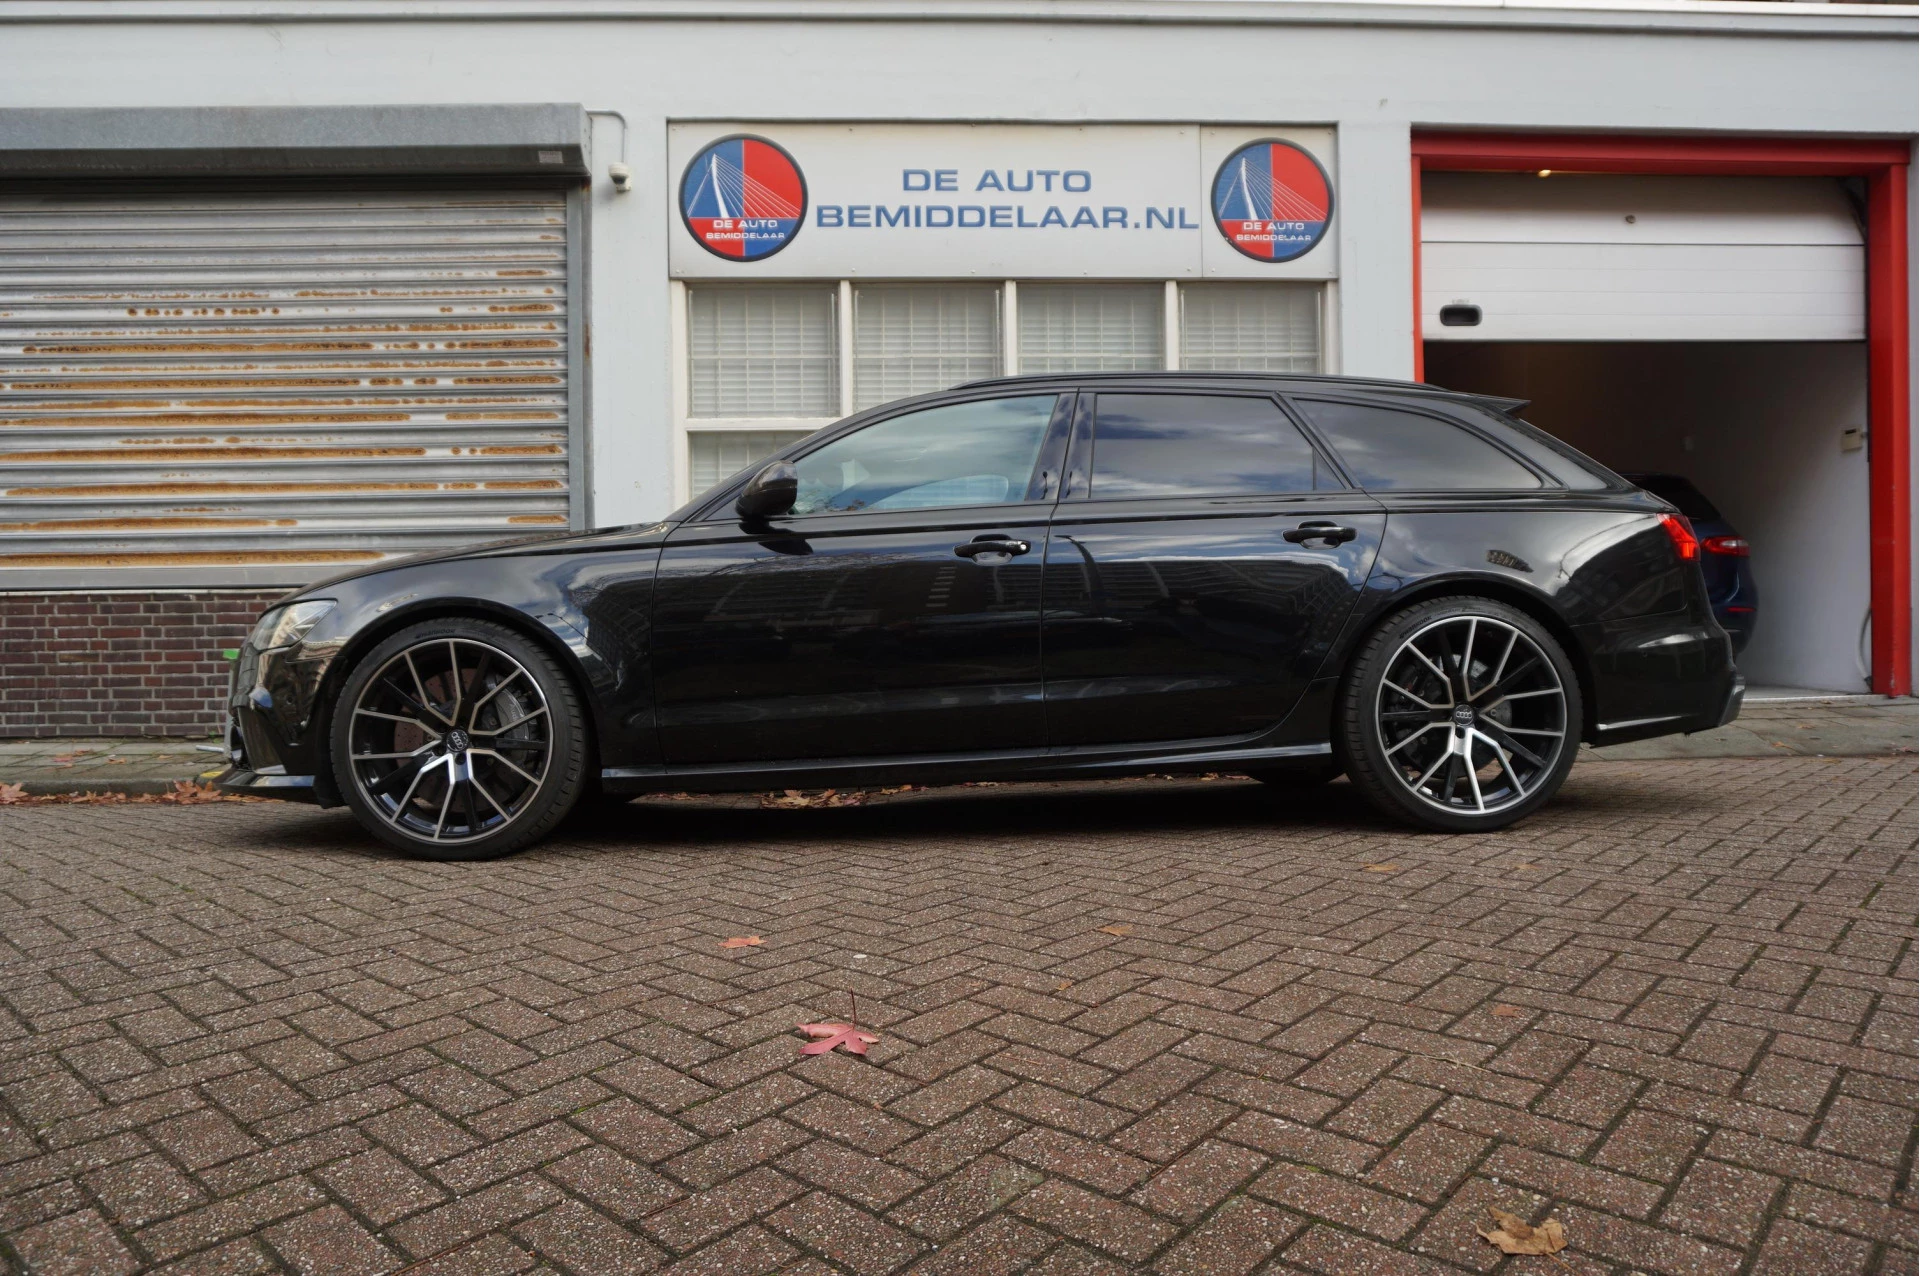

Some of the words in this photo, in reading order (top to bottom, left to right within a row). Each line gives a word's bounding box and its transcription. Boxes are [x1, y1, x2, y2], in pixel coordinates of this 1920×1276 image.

[902, 168, 959, 192] DE
[975, 169, 1092, 192] AUTO
[713, 219, 733, 228] DE
[738, 219, 778, 228] AUTO
[816, 205, 1199, 229] BEMIDDELAAR.NL
[1243, 222, 1262, 231] DE
[1267, 222, 1305, 231] AUTO
